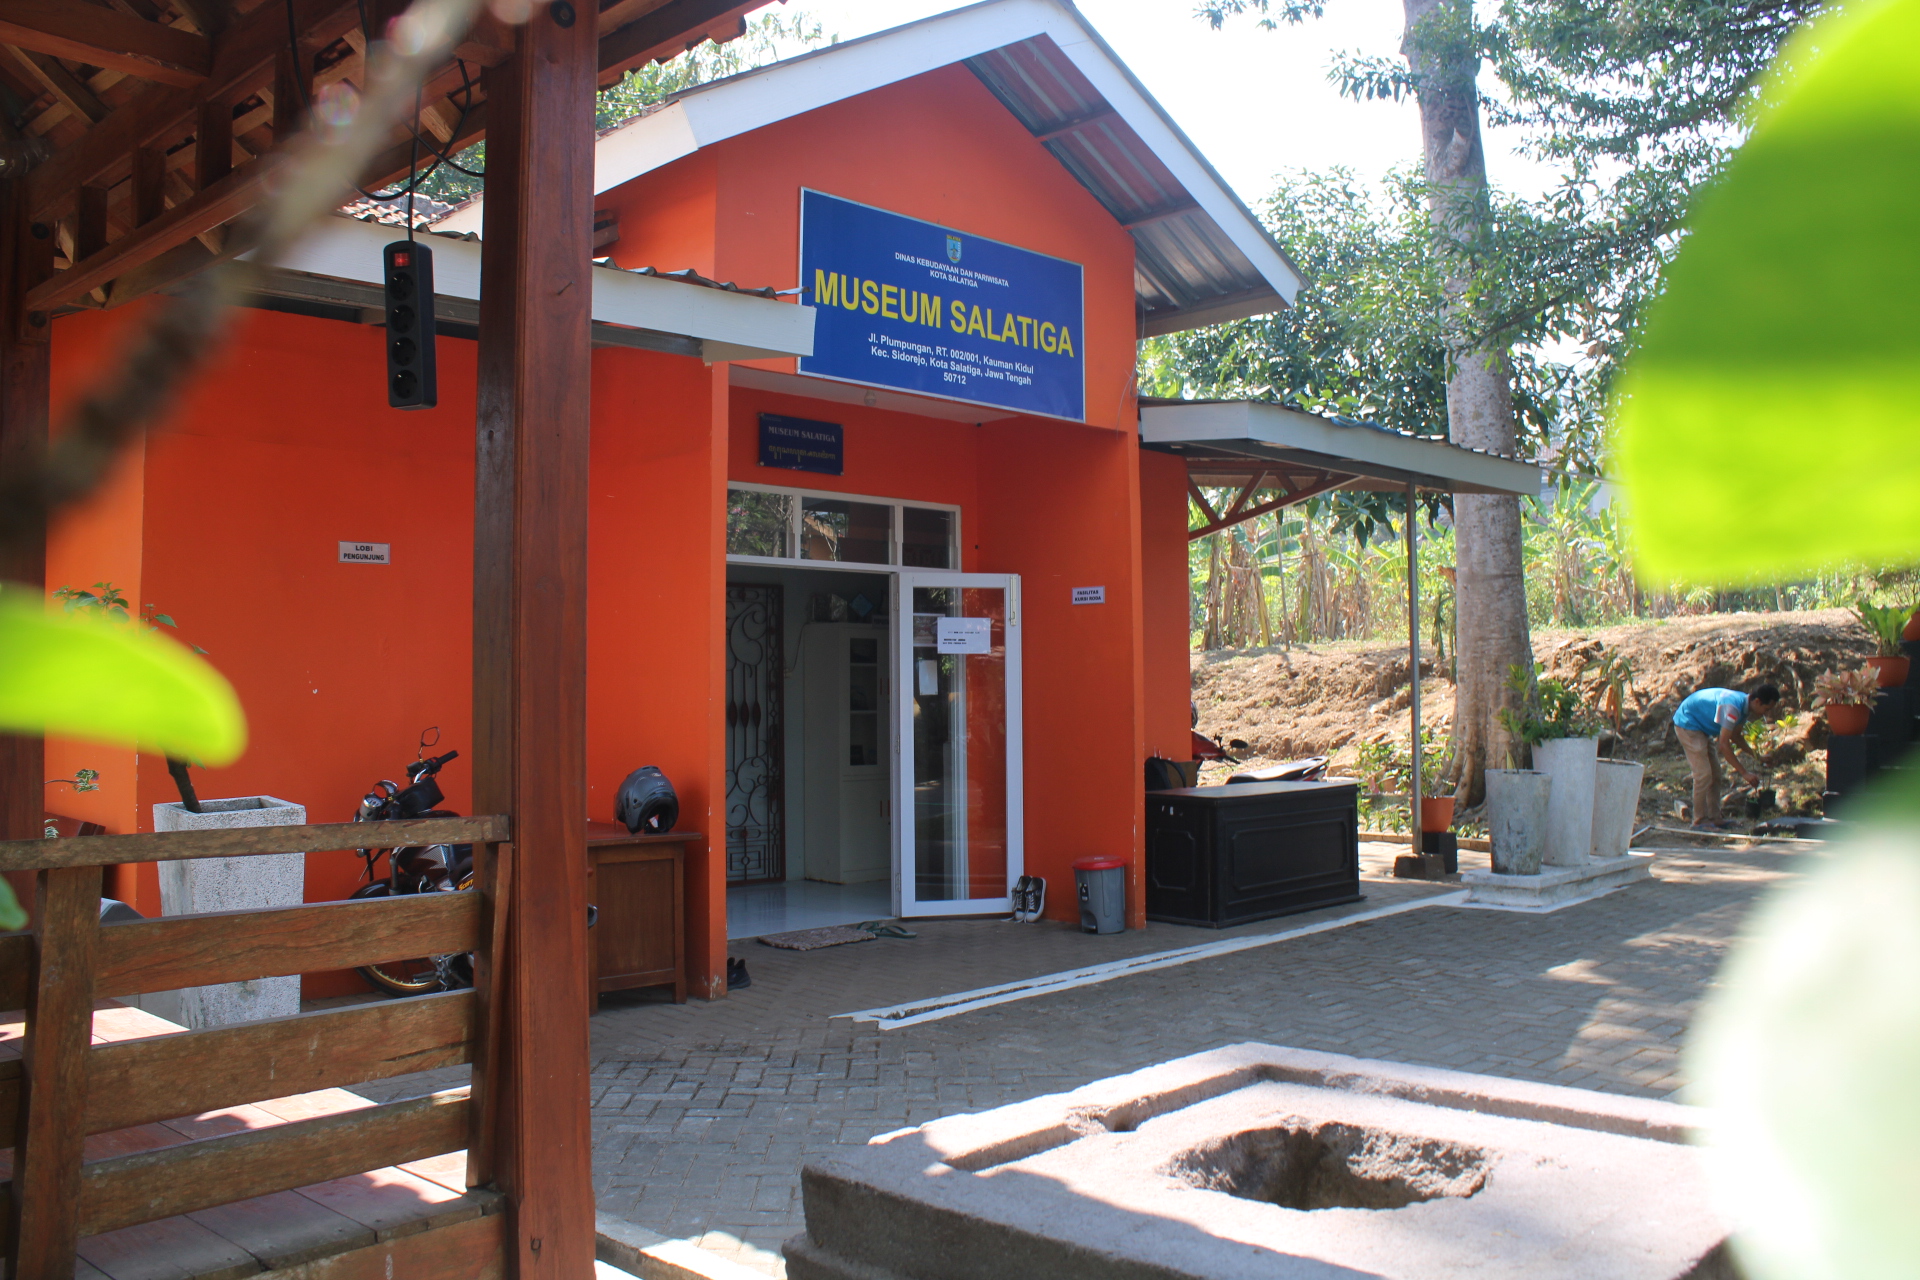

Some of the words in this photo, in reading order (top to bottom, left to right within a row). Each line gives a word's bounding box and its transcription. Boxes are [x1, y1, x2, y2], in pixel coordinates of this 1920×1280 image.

[895, 252, 915, 263] DINAS
[917, 257, 959, 274] KEBUDAYAAN
[960, 268, 973, 278] DAN
[974, 272, 1009, 287] PARIWISATA
[930, 270, 947, 280] KOTA
[948, 274, 978, 288] SALATIGA
[815, 269, 941, 328] MUSEUM
[950, 300, 1074, 357] SALATIGA
[868, 333, 878, 343] Jl.
[880, 335, 934, 355] Plumpungan,
[936, 346, 948, 357] RT.
[950, 349, 981, 364] 002/001,
[983, 356, 1013, 370] Kauman
[1015, 361, 1034, 374] Kidul
[871, 346, 889, 358] Kec.
[892, 351, 928, 367] Sidorejo,
[930, 357, 948, 369] Kota
[950, 361, 983, 377] Salatiga,
[984, 368, 1004, 380] Jawa
[1005, 372, 1032, 386] Tengah
[943, 372, 966, 385] 50712
[768, 426, 799, 437] MUSEUM
[801, 431, 836, 442] SALATIGA
